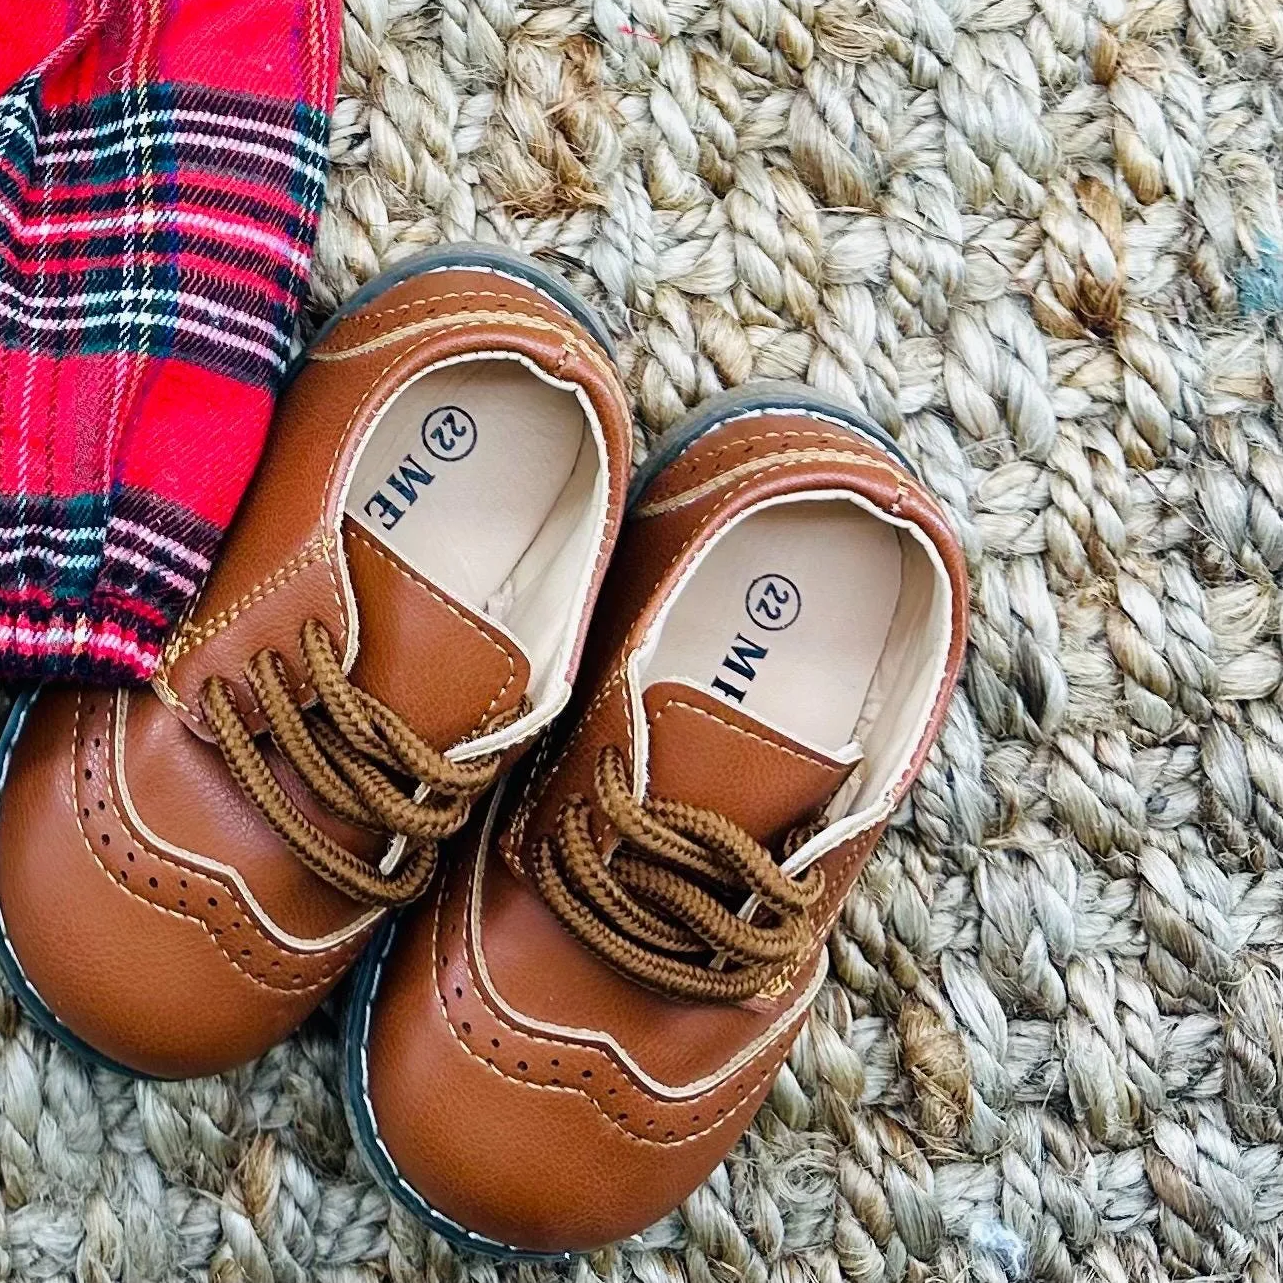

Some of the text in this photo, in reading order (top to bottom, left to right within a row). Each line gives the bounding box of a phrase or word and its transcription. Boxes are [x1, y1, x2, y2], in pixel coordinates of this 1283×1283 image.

[363, 410, 469, 530] 22 ME
[753, 579, 792, 623] 22
